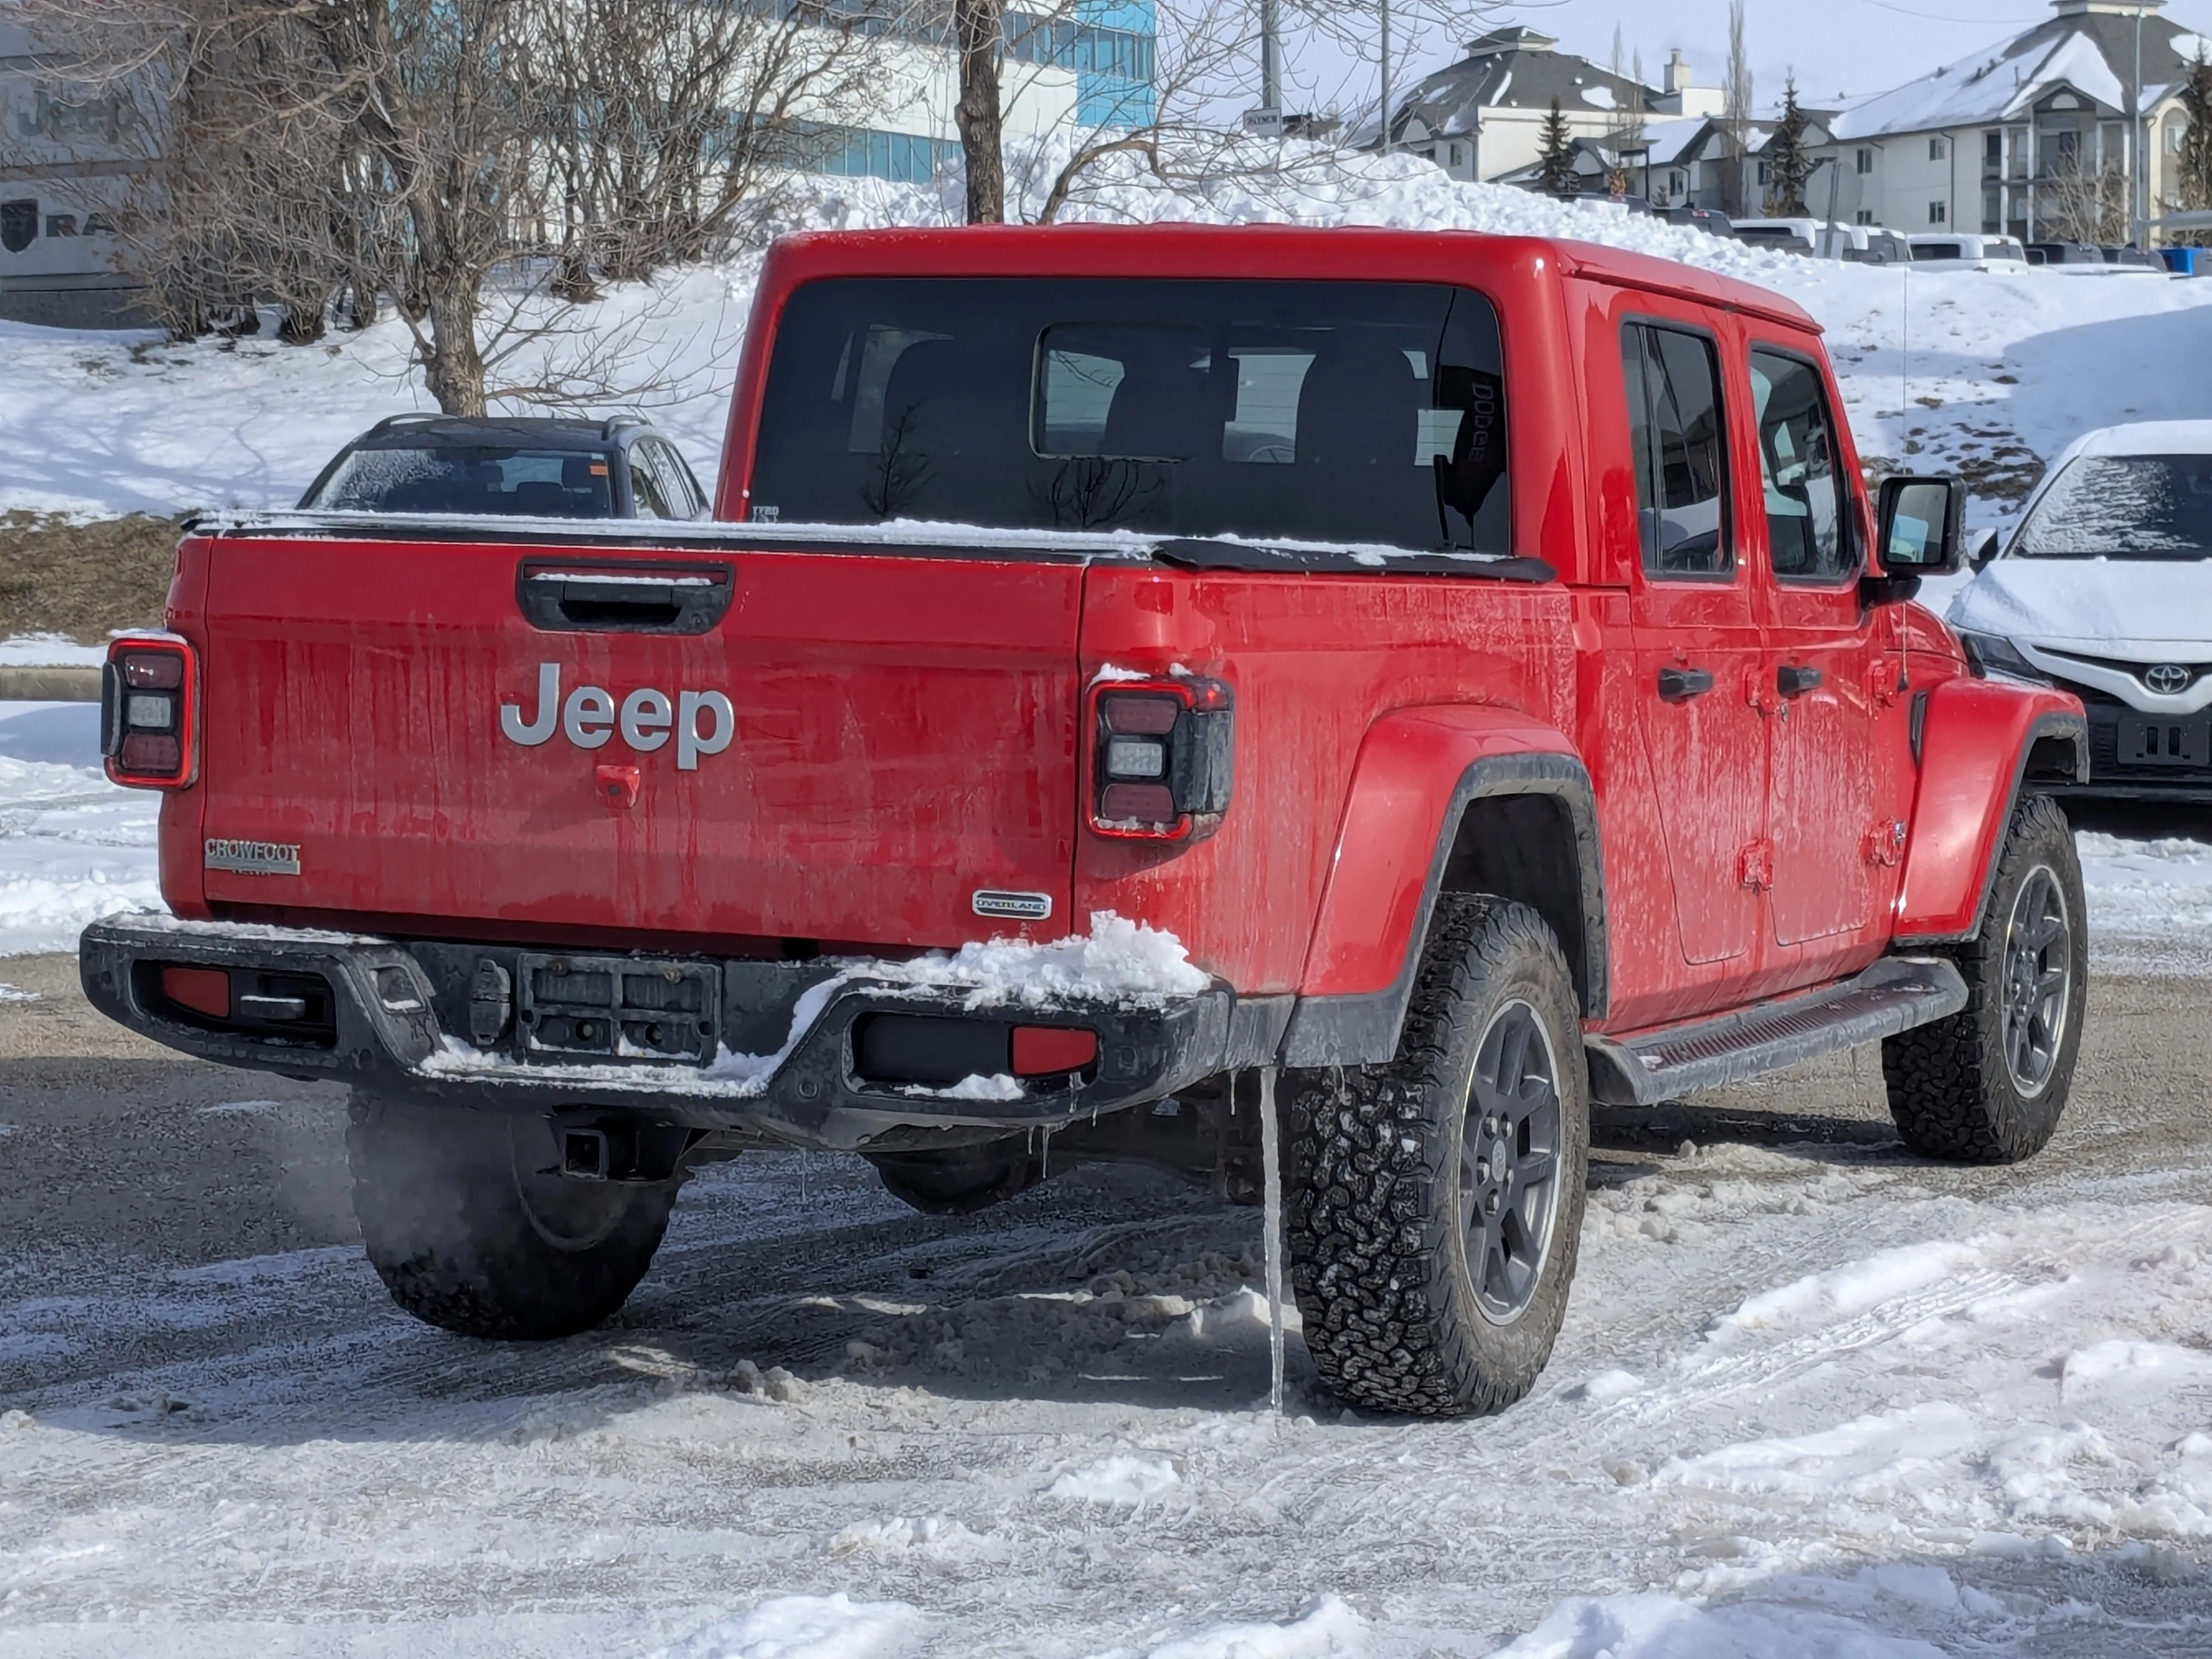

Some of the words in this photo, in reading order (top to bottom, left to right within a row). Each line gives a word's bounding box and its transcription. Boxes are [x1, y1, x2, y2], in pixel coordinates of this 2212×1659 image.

[46, 213, 144, 238] RA
[1470, 383, 1495, 461] DODGE
[500, 662, 735, 770] Jeep
[205, 838, 301, 862] CROWFOOT
[975, 899, 1046, 910] OVERLAND
